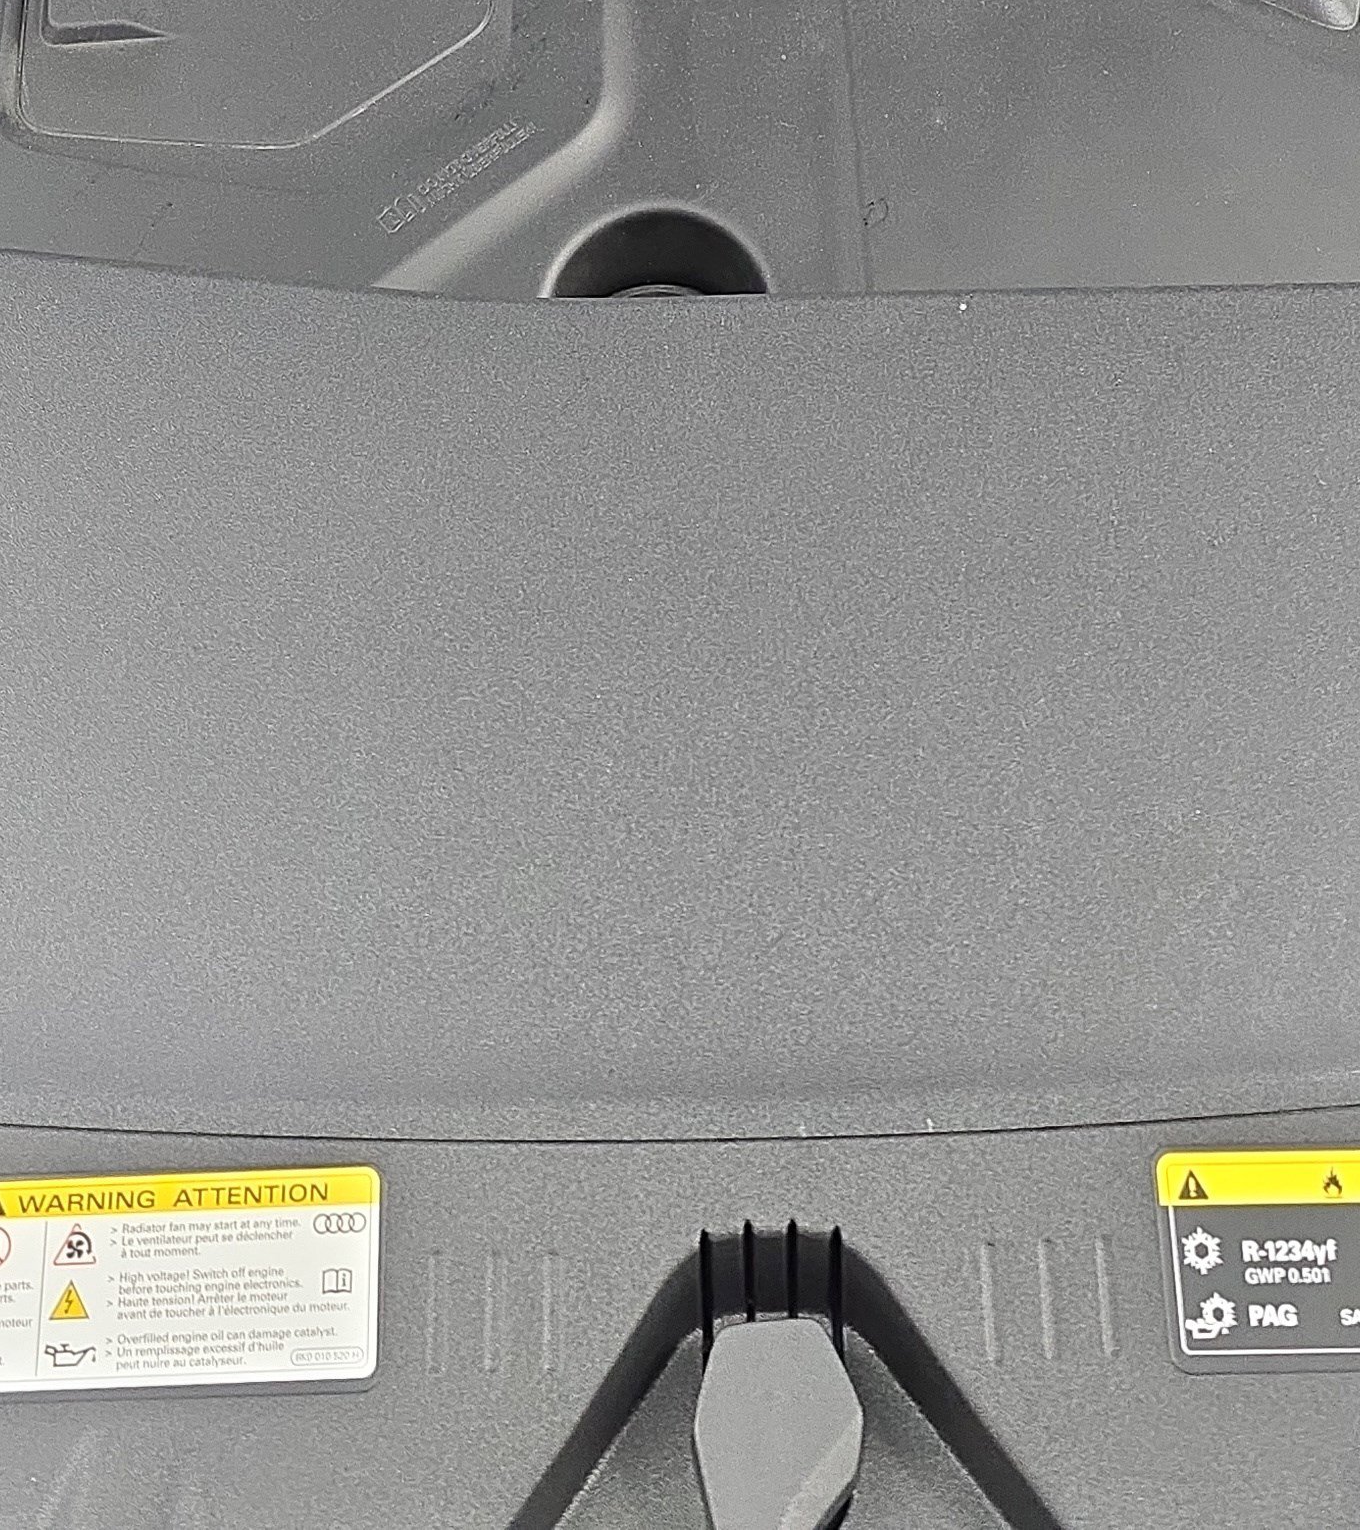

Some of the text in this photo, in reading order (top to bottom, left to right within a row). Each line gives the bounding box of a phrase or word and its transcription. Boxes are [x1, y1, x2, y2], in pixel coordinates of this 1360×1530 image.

[18, 1183, 330, 1214] WARNING ATTENTION
[122, 1218, 302, 1234] Radiator fan may start at any time.
[122, 1230, 293, 1247] Le ventilateur peut se déclencher
[130, 1248, 151, 1259] tout
[153, 1247, 201, 1258] moment.
[1242, 1238, 1338, 1266] R-1234yf
[119, 1267, 284, 1285] High voltage! Switch off engine
[1244, 1267, 1332, 1285] GWP 0.501
[5, 1281, 34, 1292] parts.
[118, 1278, 303, 1296] before touching engine electronics.
[118, 1291, 288, 1308] Haute tension! Arrêter le moteur
[117, 1309, 147, 1320] avant
[149, 1307, 162, 1319] de
[165, 1305, 206, 1318] toucher
[292, 1301, 307, 1313] du
[309, 1300, 350, 1312] moteur.
[1248, 1303, 1299, 1327] PAG
[117, 1326, 338, 1345] Overfilled engine oil can damage catalyst.
[117, 1346, 133, 1357] Un
[135, 1344, 200, 1359] remplissage
[203, 1341, 245, 1354] excessif
[116, 1355, 247, 1372] peut nuire au catalyseur.
